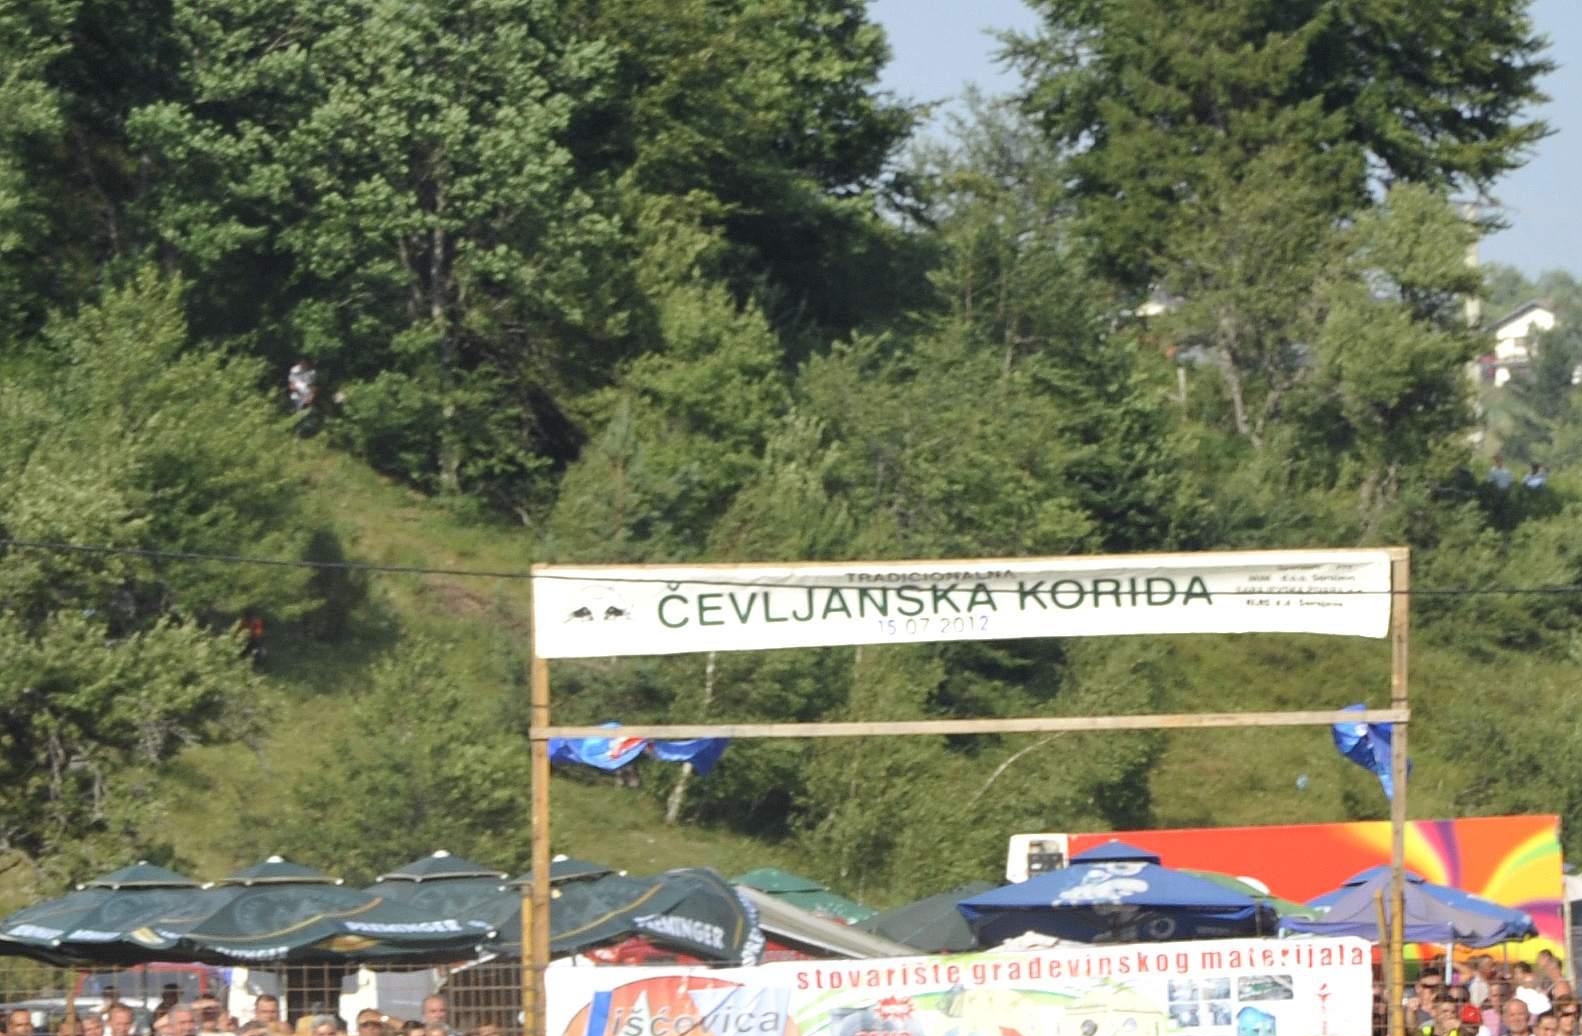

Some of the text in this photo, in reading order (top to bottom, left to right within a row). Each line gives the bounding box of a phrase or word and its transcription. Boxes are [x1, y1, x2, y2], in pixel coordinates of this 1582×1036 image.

[847, 571, 1016, 584] TRADICIONALNA
[658, 576, 1214, 628] ČEVLJANSKA KORIDA
[797, 957, 960, 989] stovarište
[1202, 944, 1364, 969] materijala
